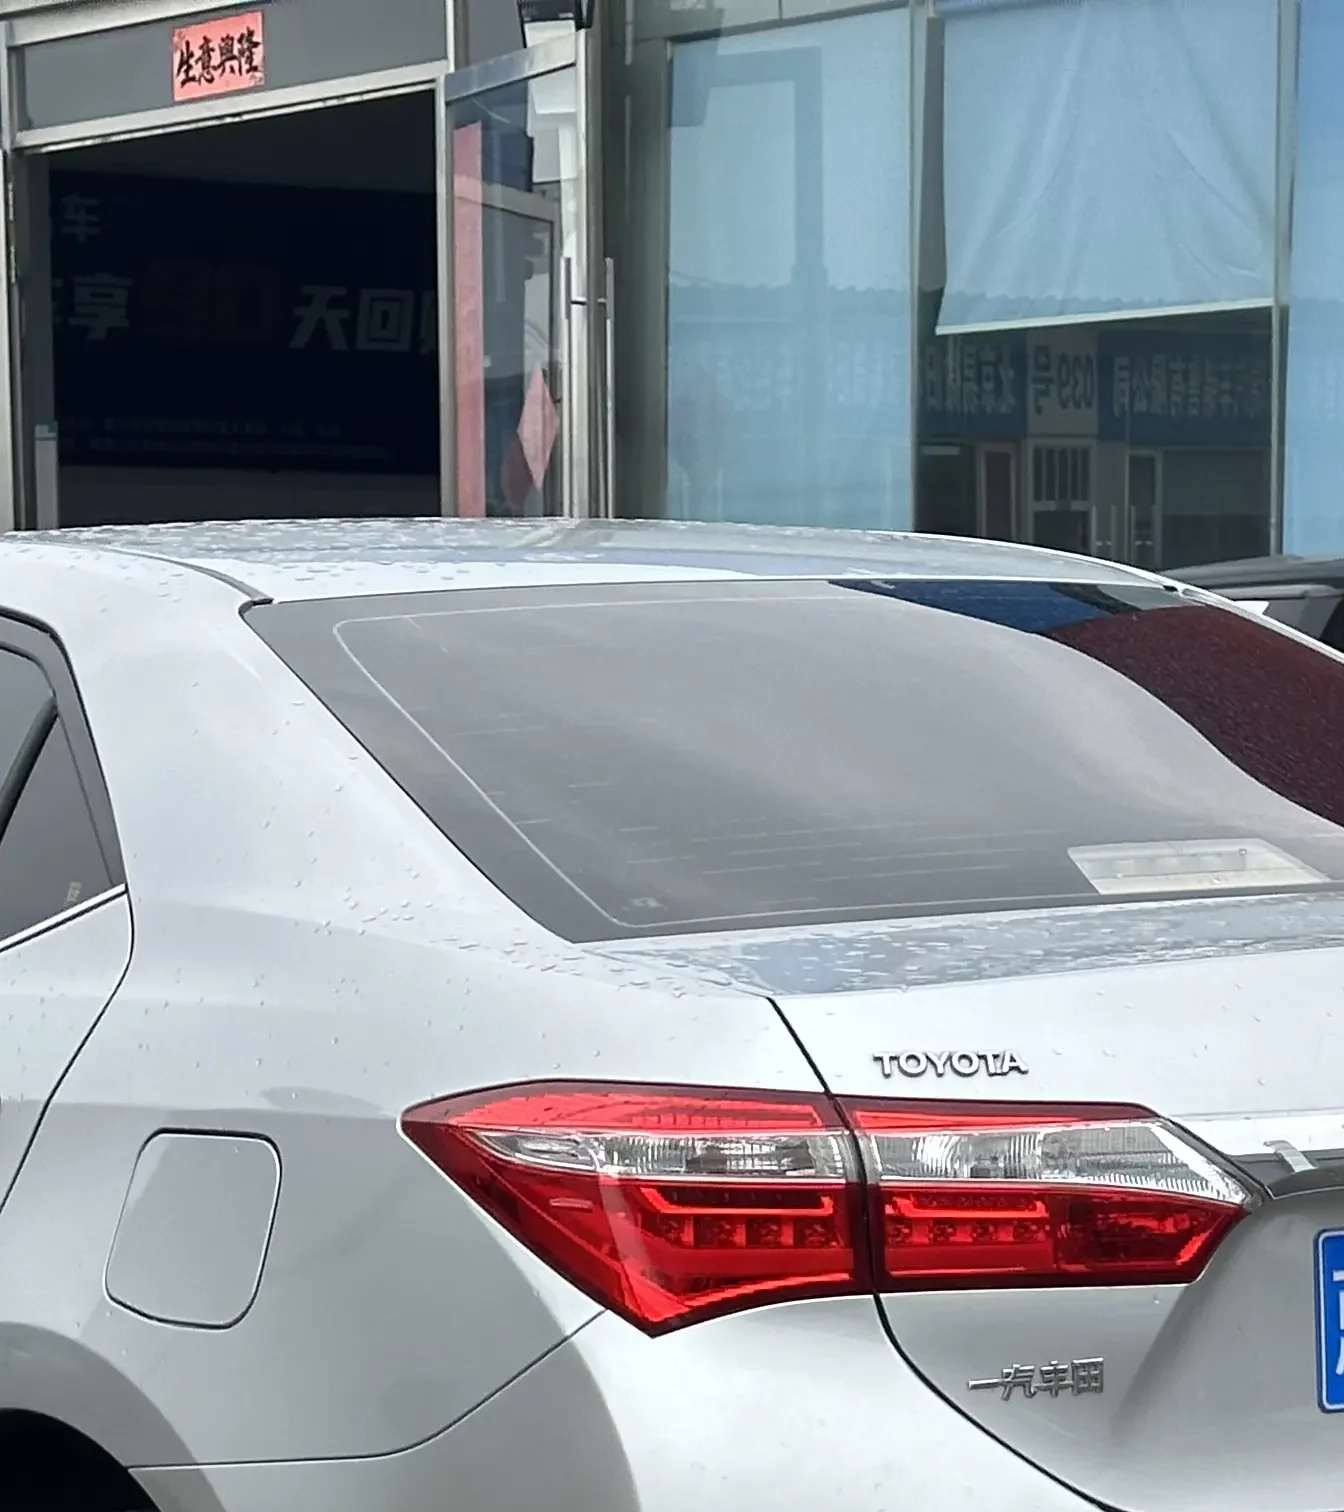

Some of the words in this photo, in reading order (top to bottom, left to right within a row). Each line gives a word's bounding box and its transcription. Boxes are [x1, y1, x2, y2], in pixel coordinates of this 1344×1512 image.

[175, 25, 261, 88] 生意興隆
[873, 1050, 1028, 1077] TOYOTA
[966, 1357, 1105, 1401] 一汽丰田
